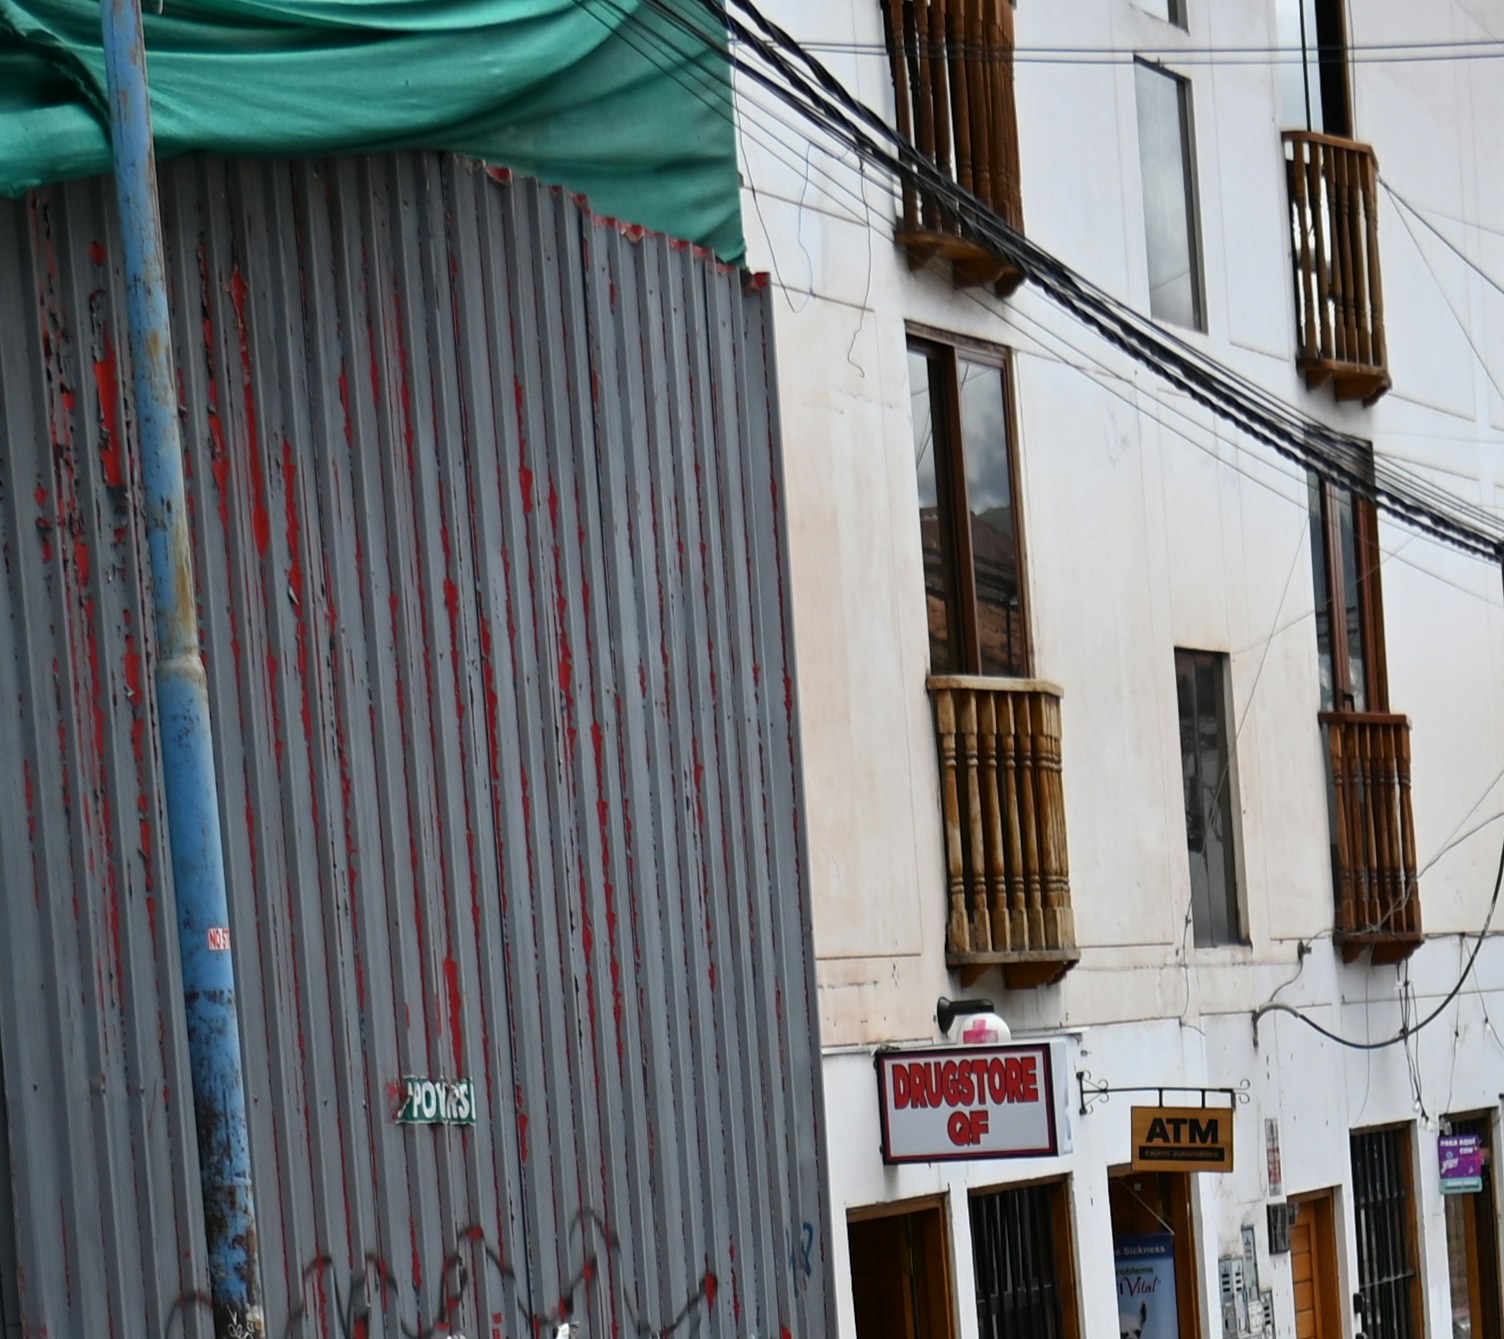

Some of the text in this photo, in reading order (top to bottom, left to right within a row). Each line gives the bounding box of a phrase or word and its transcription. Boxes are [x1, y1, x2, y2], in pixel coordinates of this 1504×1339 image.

[891, 1056, 1040, 1110] DRUGSTORE
[947, 1110, 990, 1147] QF
[1145, 1117, 1219, 1144] ATM
[1116, 1265, 1154, 1277] roblems
